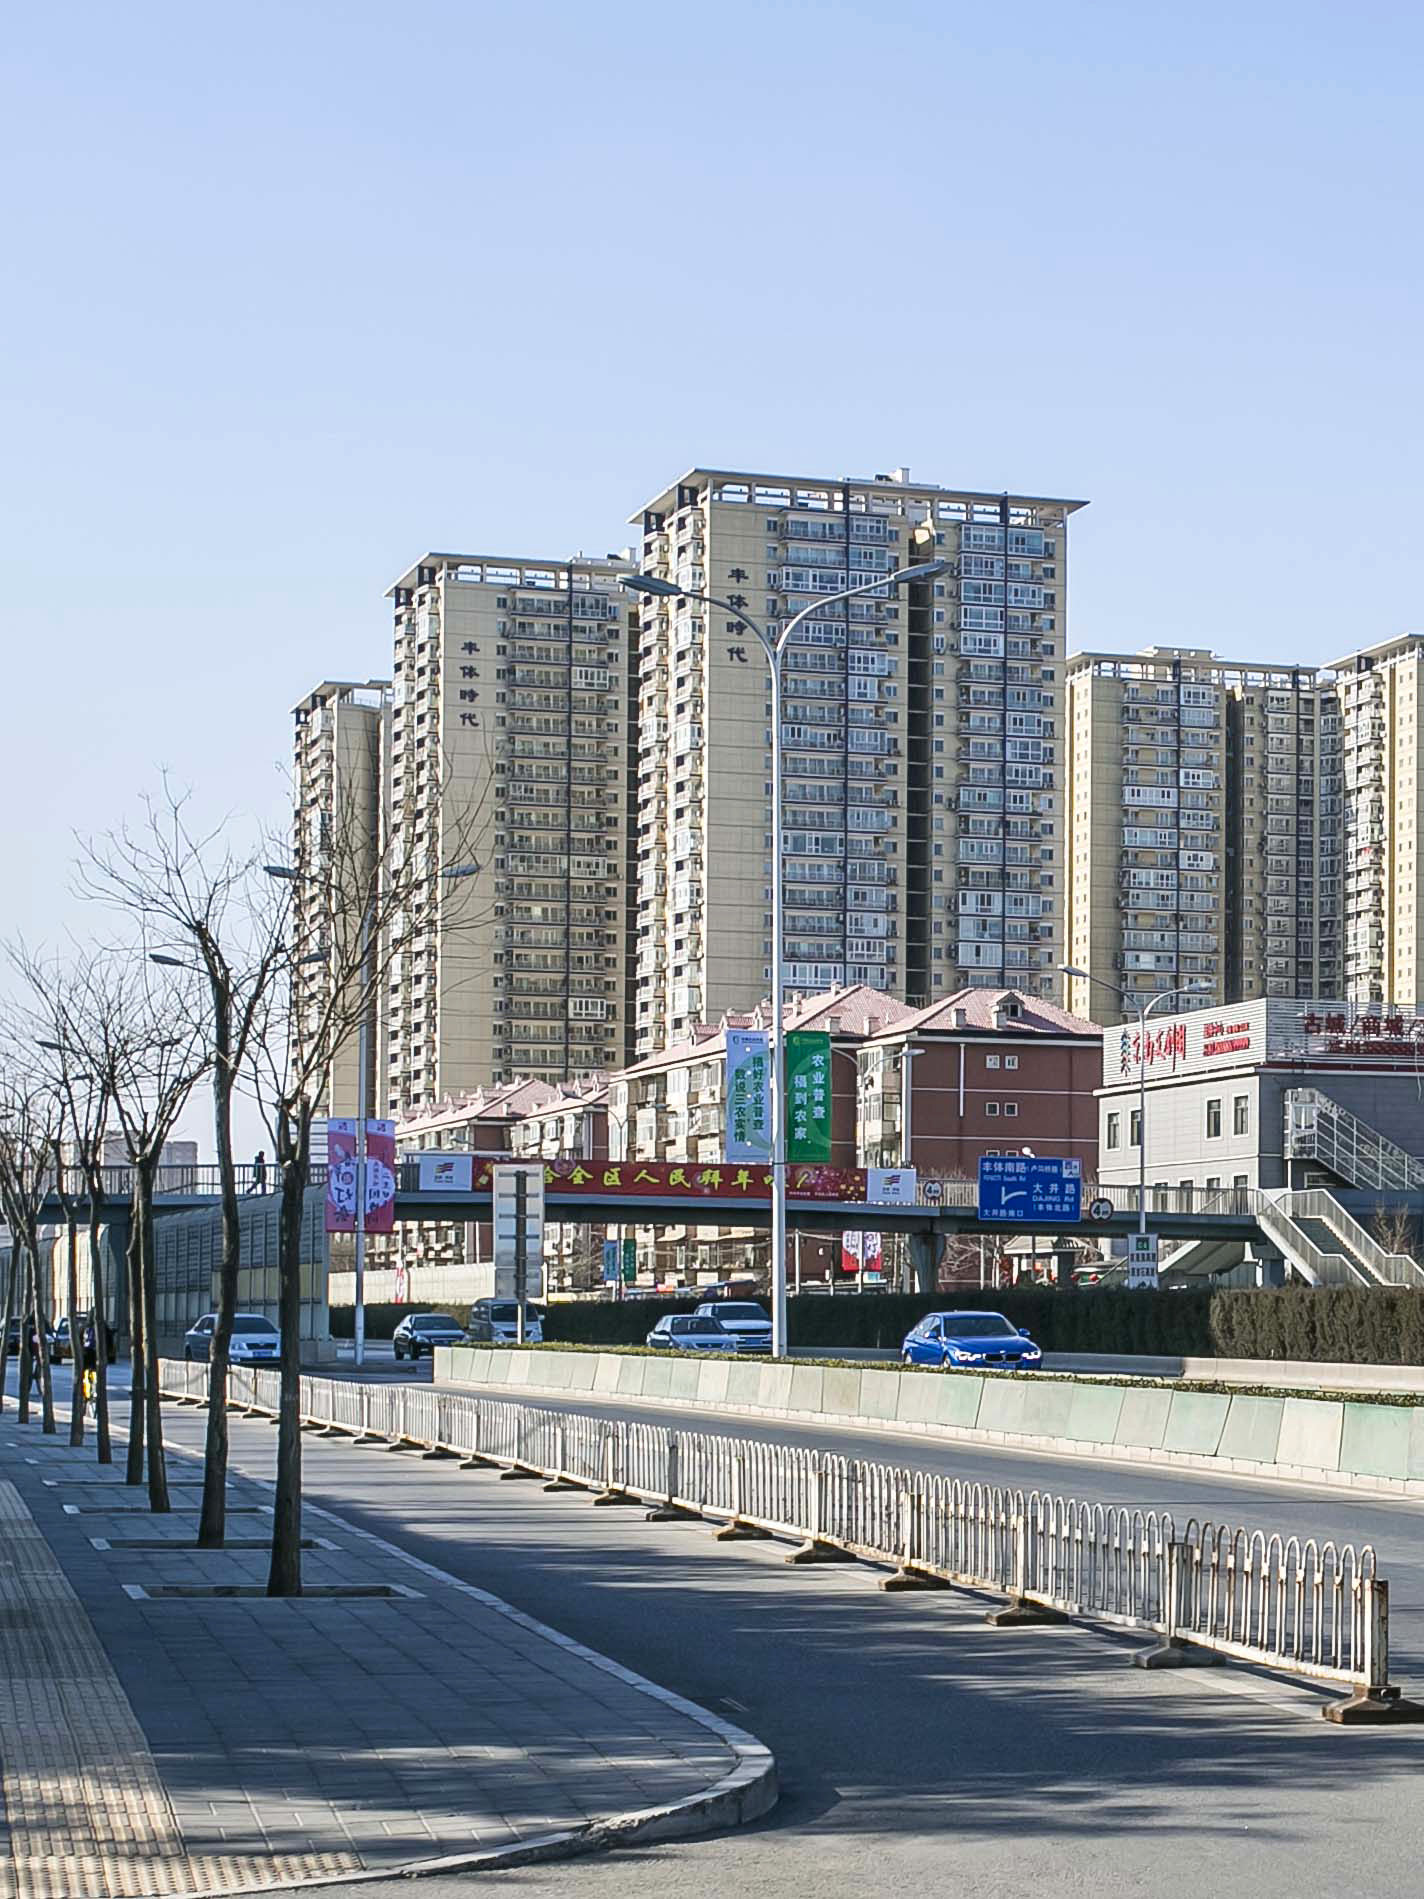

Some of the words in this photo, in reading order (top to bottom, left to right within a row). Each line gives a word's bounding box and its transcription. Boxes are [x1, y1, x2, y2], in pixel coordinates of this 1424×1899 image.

[794, 1074, 808, 1140] 福到农家
[811, 1054, 826, 1119] 农业普查
[1032, 1183, 1076, 1195] 大井路
